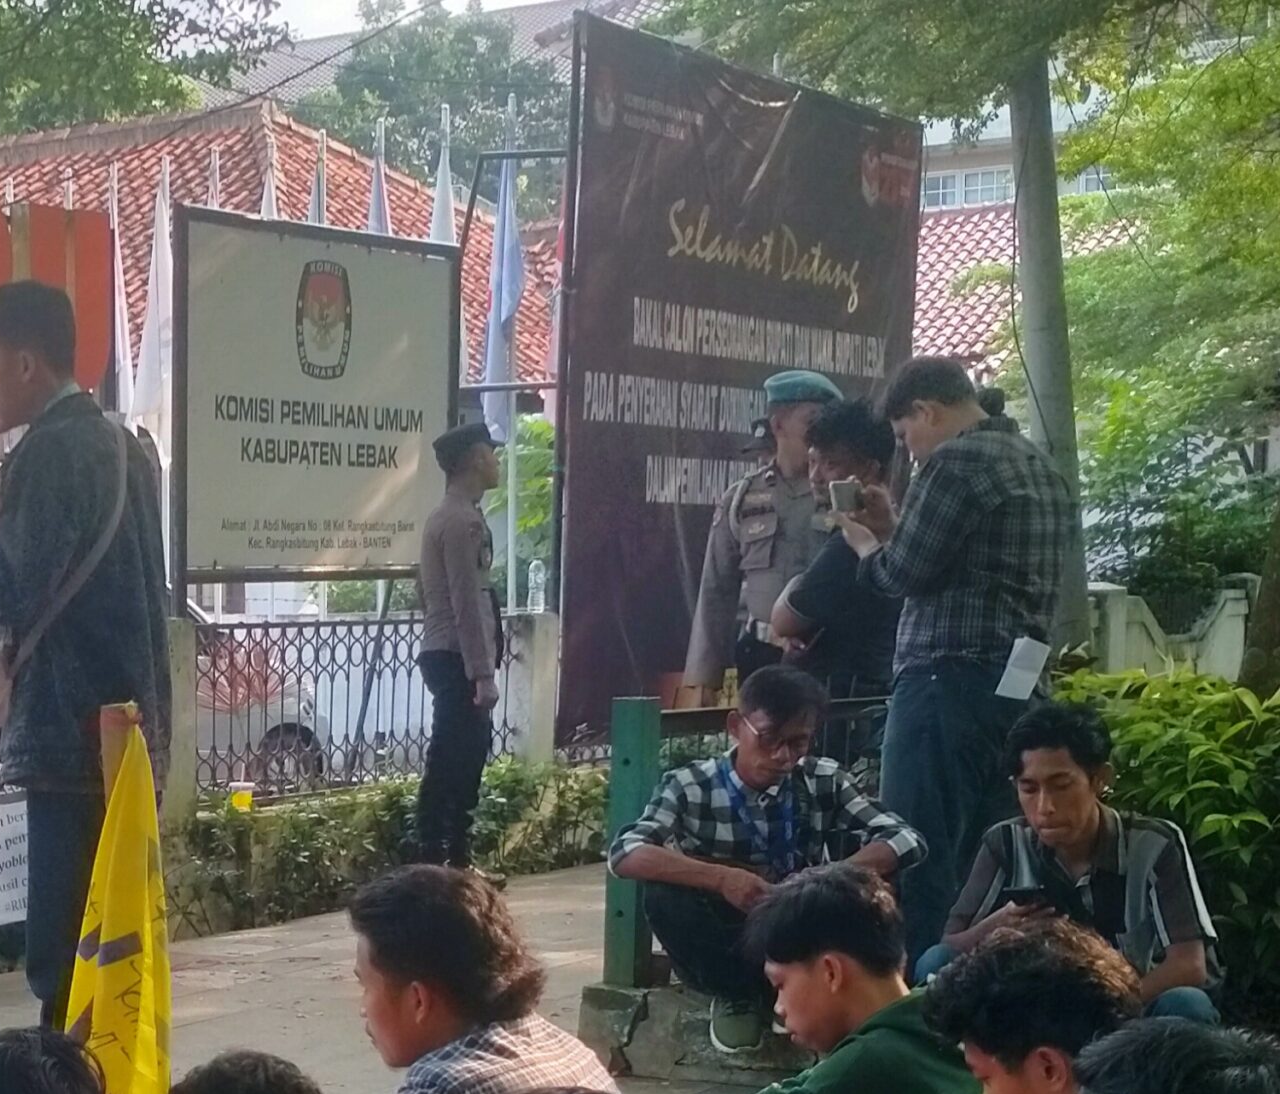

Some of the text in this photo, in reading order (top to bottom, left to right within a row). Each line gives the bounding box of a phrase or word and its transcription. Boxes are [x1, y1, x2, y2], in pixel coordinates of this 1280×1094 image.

[668, 198, 860, 313] Selamat Datang
[633, 297, 663, 350] BAKAL
[664, 303, 695, 354] CALON
[215, 394, 423, 433] KOMISI PEMILIHAN UMUM
[583, 371, 614, 422] PADA
[617, 374, 679, 429] PENYERAHAN
[679, 382, 720, 432] SYARAT
[241, 437, 399, 469] KABUPATEN LEBAK
[646, 455, 675, 504] DALAM
[281, 519, 306, 534] Negara
[363, 537, 392, 549] BANTEN
